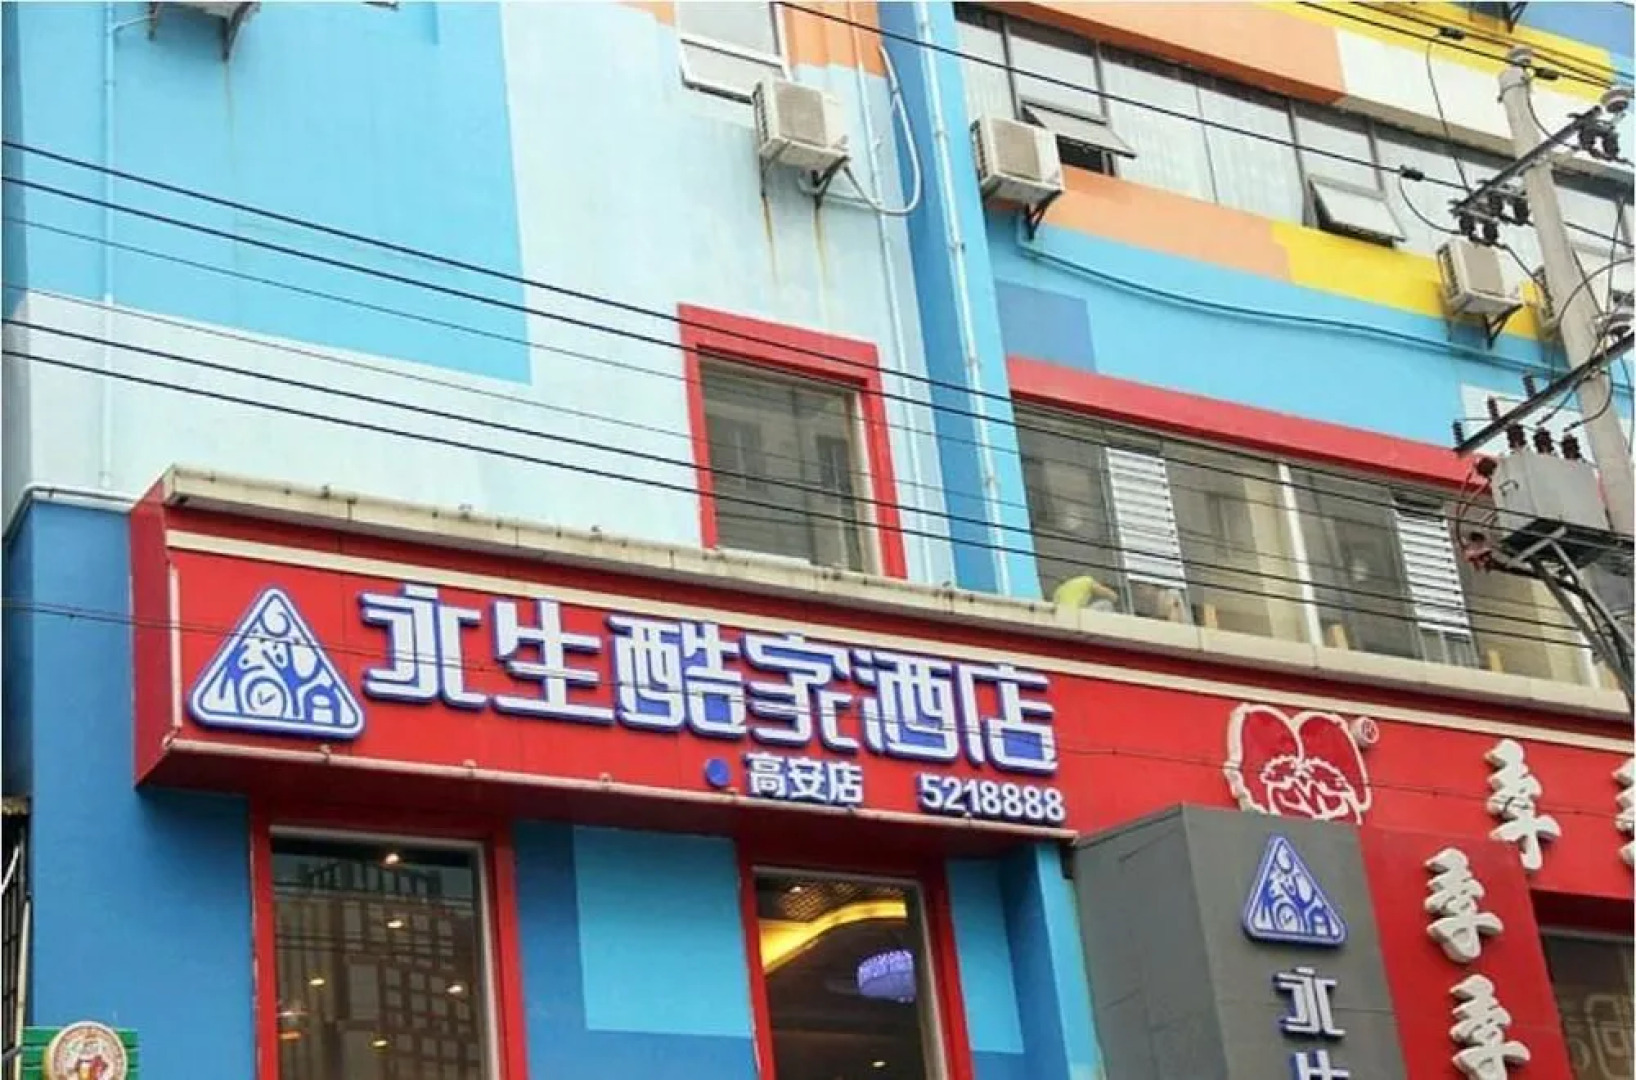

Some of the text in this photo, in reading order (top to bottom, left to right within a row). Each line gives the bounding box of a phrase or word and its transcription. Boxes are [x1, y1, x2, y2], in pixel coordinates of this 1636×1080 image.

[361, 584, 1057, 774] 永生酷家酒店
[746, 752, 1066, 824] 高安店 5218888
